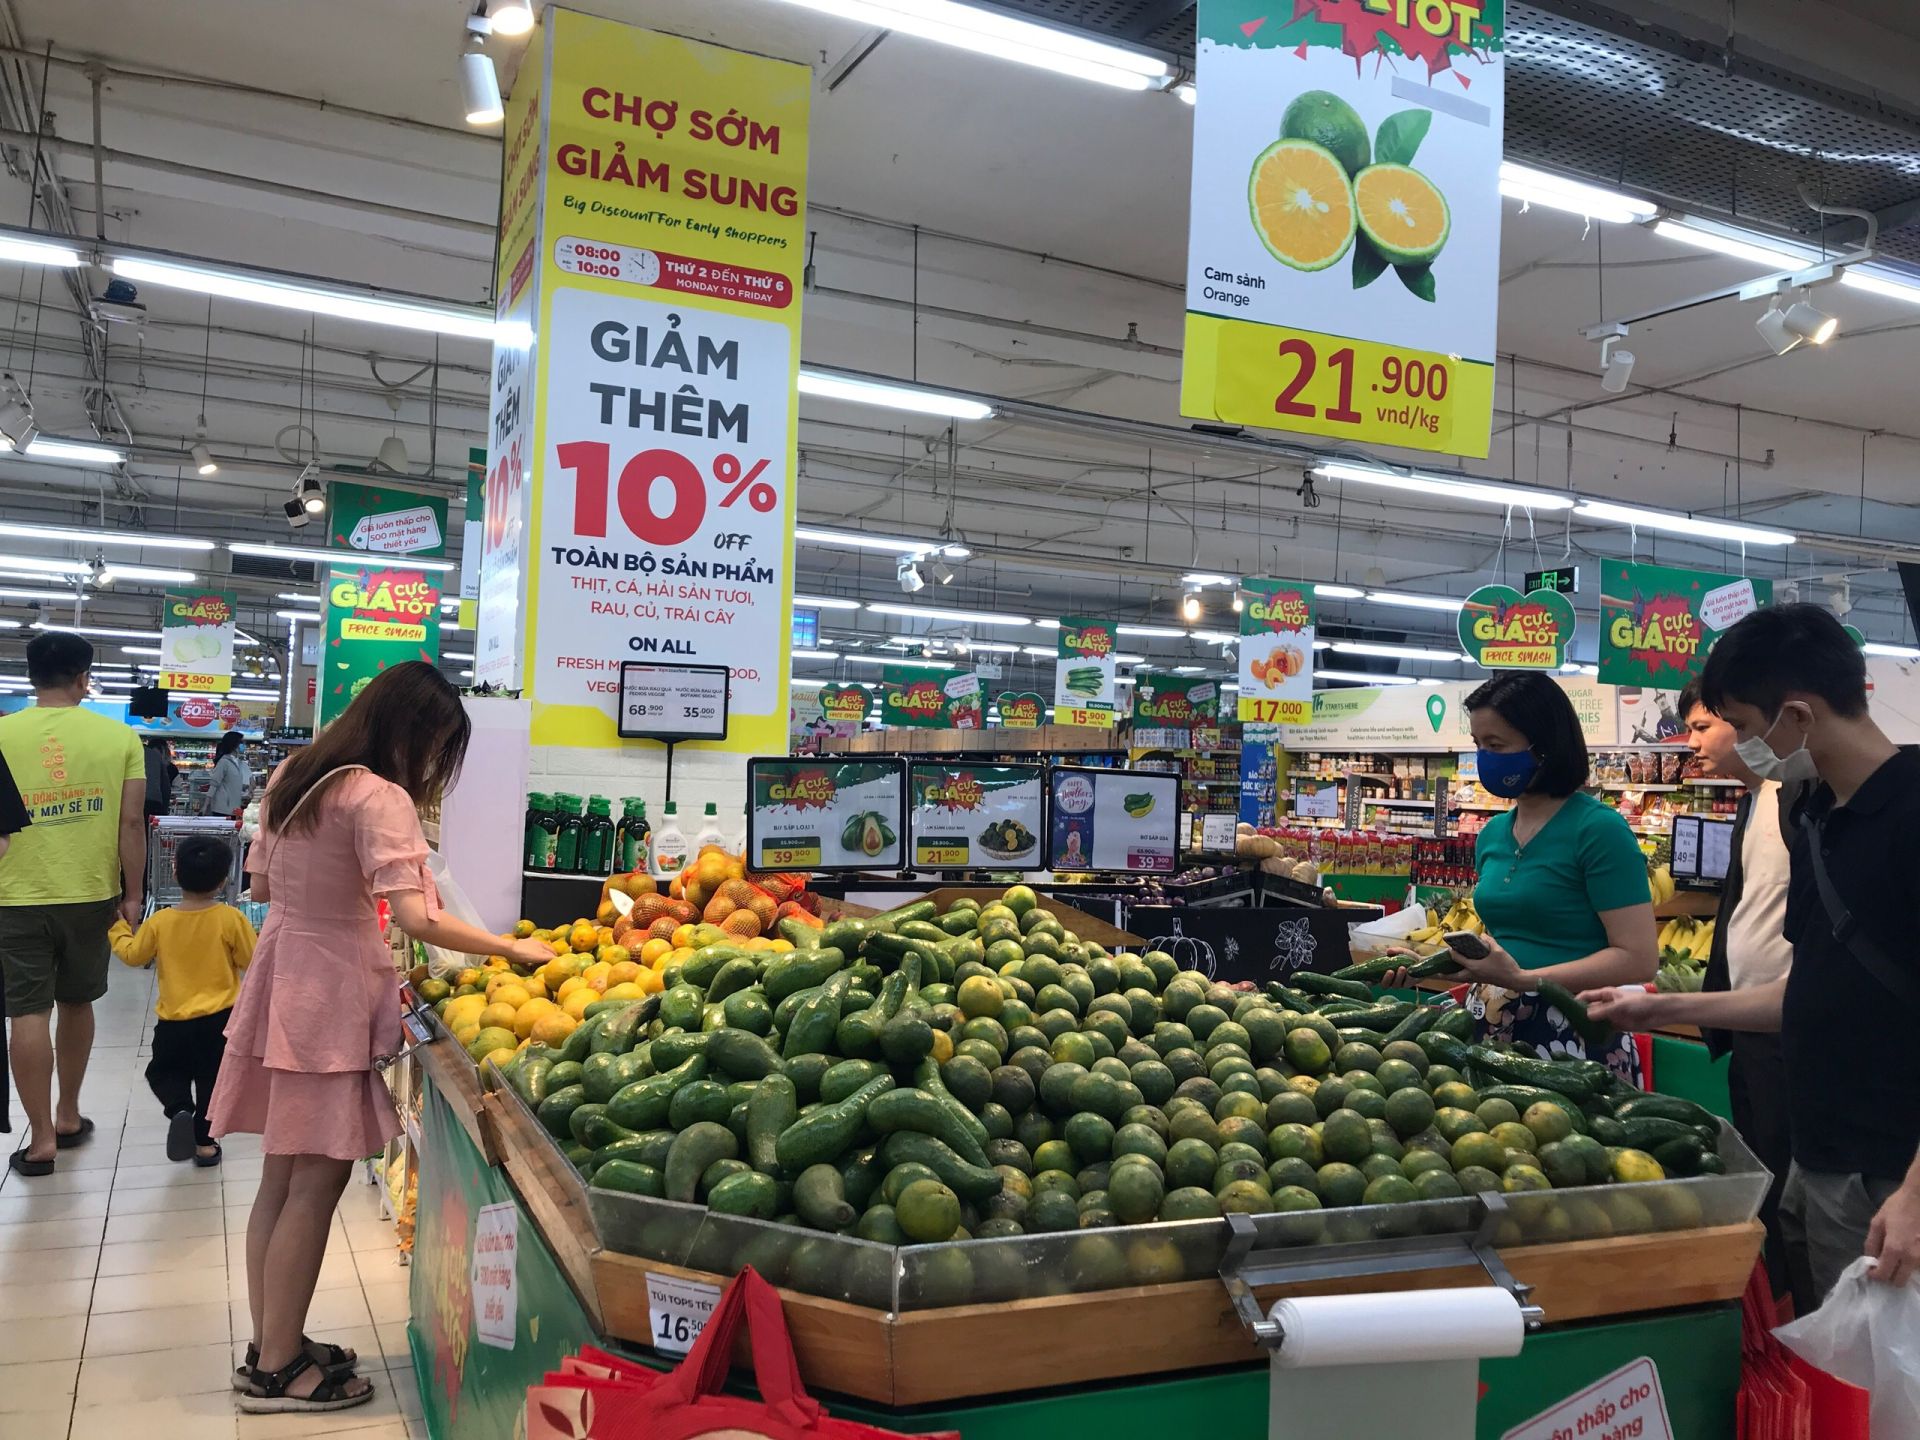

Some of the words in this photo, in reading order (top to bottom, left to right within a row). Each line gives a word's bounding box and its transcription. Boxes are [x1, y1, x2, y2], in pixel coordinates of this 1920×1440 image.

[582, 86, 679, 140] CHỢ
[688, 107, 780, 155] SỚM
[556, 140, 670, 193] GIẢM
[682, 169, 799, 217] SUNG
[563, 195, 586, 214] Big
[686, 218, 720, 239] Early
[725, 226, 788, 249] Shoppers
[574, 243, 621, 263] 08:00
[576, 260, 621, 278] 10:00
[665, 260, 697, 276] THỨ
[699, 266, 708, 278] 2
[711, 267, 740, 285] ĐẾN
[743, 274, 774, 290] THỨ
[775, 280, 785, 292] 6
[1203, 266, 1234, 285] Cam
[1235, 269, 1267, 291] sành
[676, 278, 719, 294] MONDAY
[721, 286, 736, 297] TO
[738, 288, 774, 303] FRIDAY
[1202, 286, 1251, 307] Orange
[590, 312, 739, 381] GIẢM
[589, 381, 750, 444] THÊM
[1376, 403, 1441, 434] vnd/kg
[415, 515, 431, 524] cho
[370, 532, 388, 542] 500
[713, 533, 753, 552] OFF
[551, 546, 619, 570] TOÀN
[623, 551, 657, 577] BỘ
[661, 552, 708, 581] SẢN
[712, 557, 774, 585] PHẨM
[570, 575, 611, 595] THỊT,
[615, 577, 642, 597] CÁ,
[646, 581, 674, 598] HẢI
[678, 584, 711, 601] SẢN
[715, 588, 755, 607] TƯƠI,
[1529, 580, 1541, 589] EXIT
[331, 580, 397, 612] GIÁ
[394, 582, 430, 598] CỰC
[173, 603, 207, 618] GIÁ
[207, 609, 230, 621] TỐT
[395, 597, 436, 616] TỐT
[591, 600, 630, 619] RAU,
[633, 600, 660, 621] CỦ,
[664, 604, 700, 622] TRÁI
[704, 608, 736, 625] CÂY
[1250, 601, 1286, 622] GIÁ
[1283, 599, 1305, 612] CỰC
[1285, 610, 1309, 626] TỐT
[1473, 613, 1527, 643] GIÁ
[1523, 611, 1554, 629] CỰC
[348, 623, 379, 635] PRICE
[384, 626, 422, 639] SMASH
[1524, 626, 1559, 645] TỐT
[1610, 612, 1666, 651] GIÁ
[1663, 611, 1693, 635] CỰC
[628, 636, 658, 652] ON
[660, 637, 697, 655] ALL
[1065, 632, 1093, 650] GIÁ
[1093, 641, 1112, 653] TỐT
[1665, 631, 1700, 655] TỐT
[556, 656, 605, 671] FRESH
[1485, 650, 1514, 663] PRICE
[1517, 650, 1551, 664] SMASH
[167, 673, 189, 689] 13
[888, 690, 922, 708] GIÁ
[921, 689, 940, 699] CỰC
[922, 697, 944, 710] TỐT
[1344, 702, 1358, 710] HERE
[1579, 699, 1604, 711] FREE
[629, 704, 647, 716] 68
[683, 706, 699, 718] 35
[1139, 699, 1171, 718] GIÁ
[1253, 700, 1279, 722] 17
[769, 779, 808, 800] GIÁ
[806, 776, 831, 789] CỰC
[808, 787, 835, 801] TỐT
[925, 781, 960, 801] GIÁ
[959, 789, 982, 802] TỐT
[41, 803, 66, 817] MAY
[69, 797, 82, 813] SẼ
[87, 796, 104, 811] TỚI
[774, 850, 793, 864] 39
[927, 850, 942, 863] 21
[1138, 855, 1155, 869] 39
[651, 1289, 667, 1302] TÚI
[668, 1294, 694, 1309] TOPS
[657, 1312, 689, 1343] 16
[1576, 1398, 1616, 1436] thấp
[1619, 1383, 1650, 1410] cho
